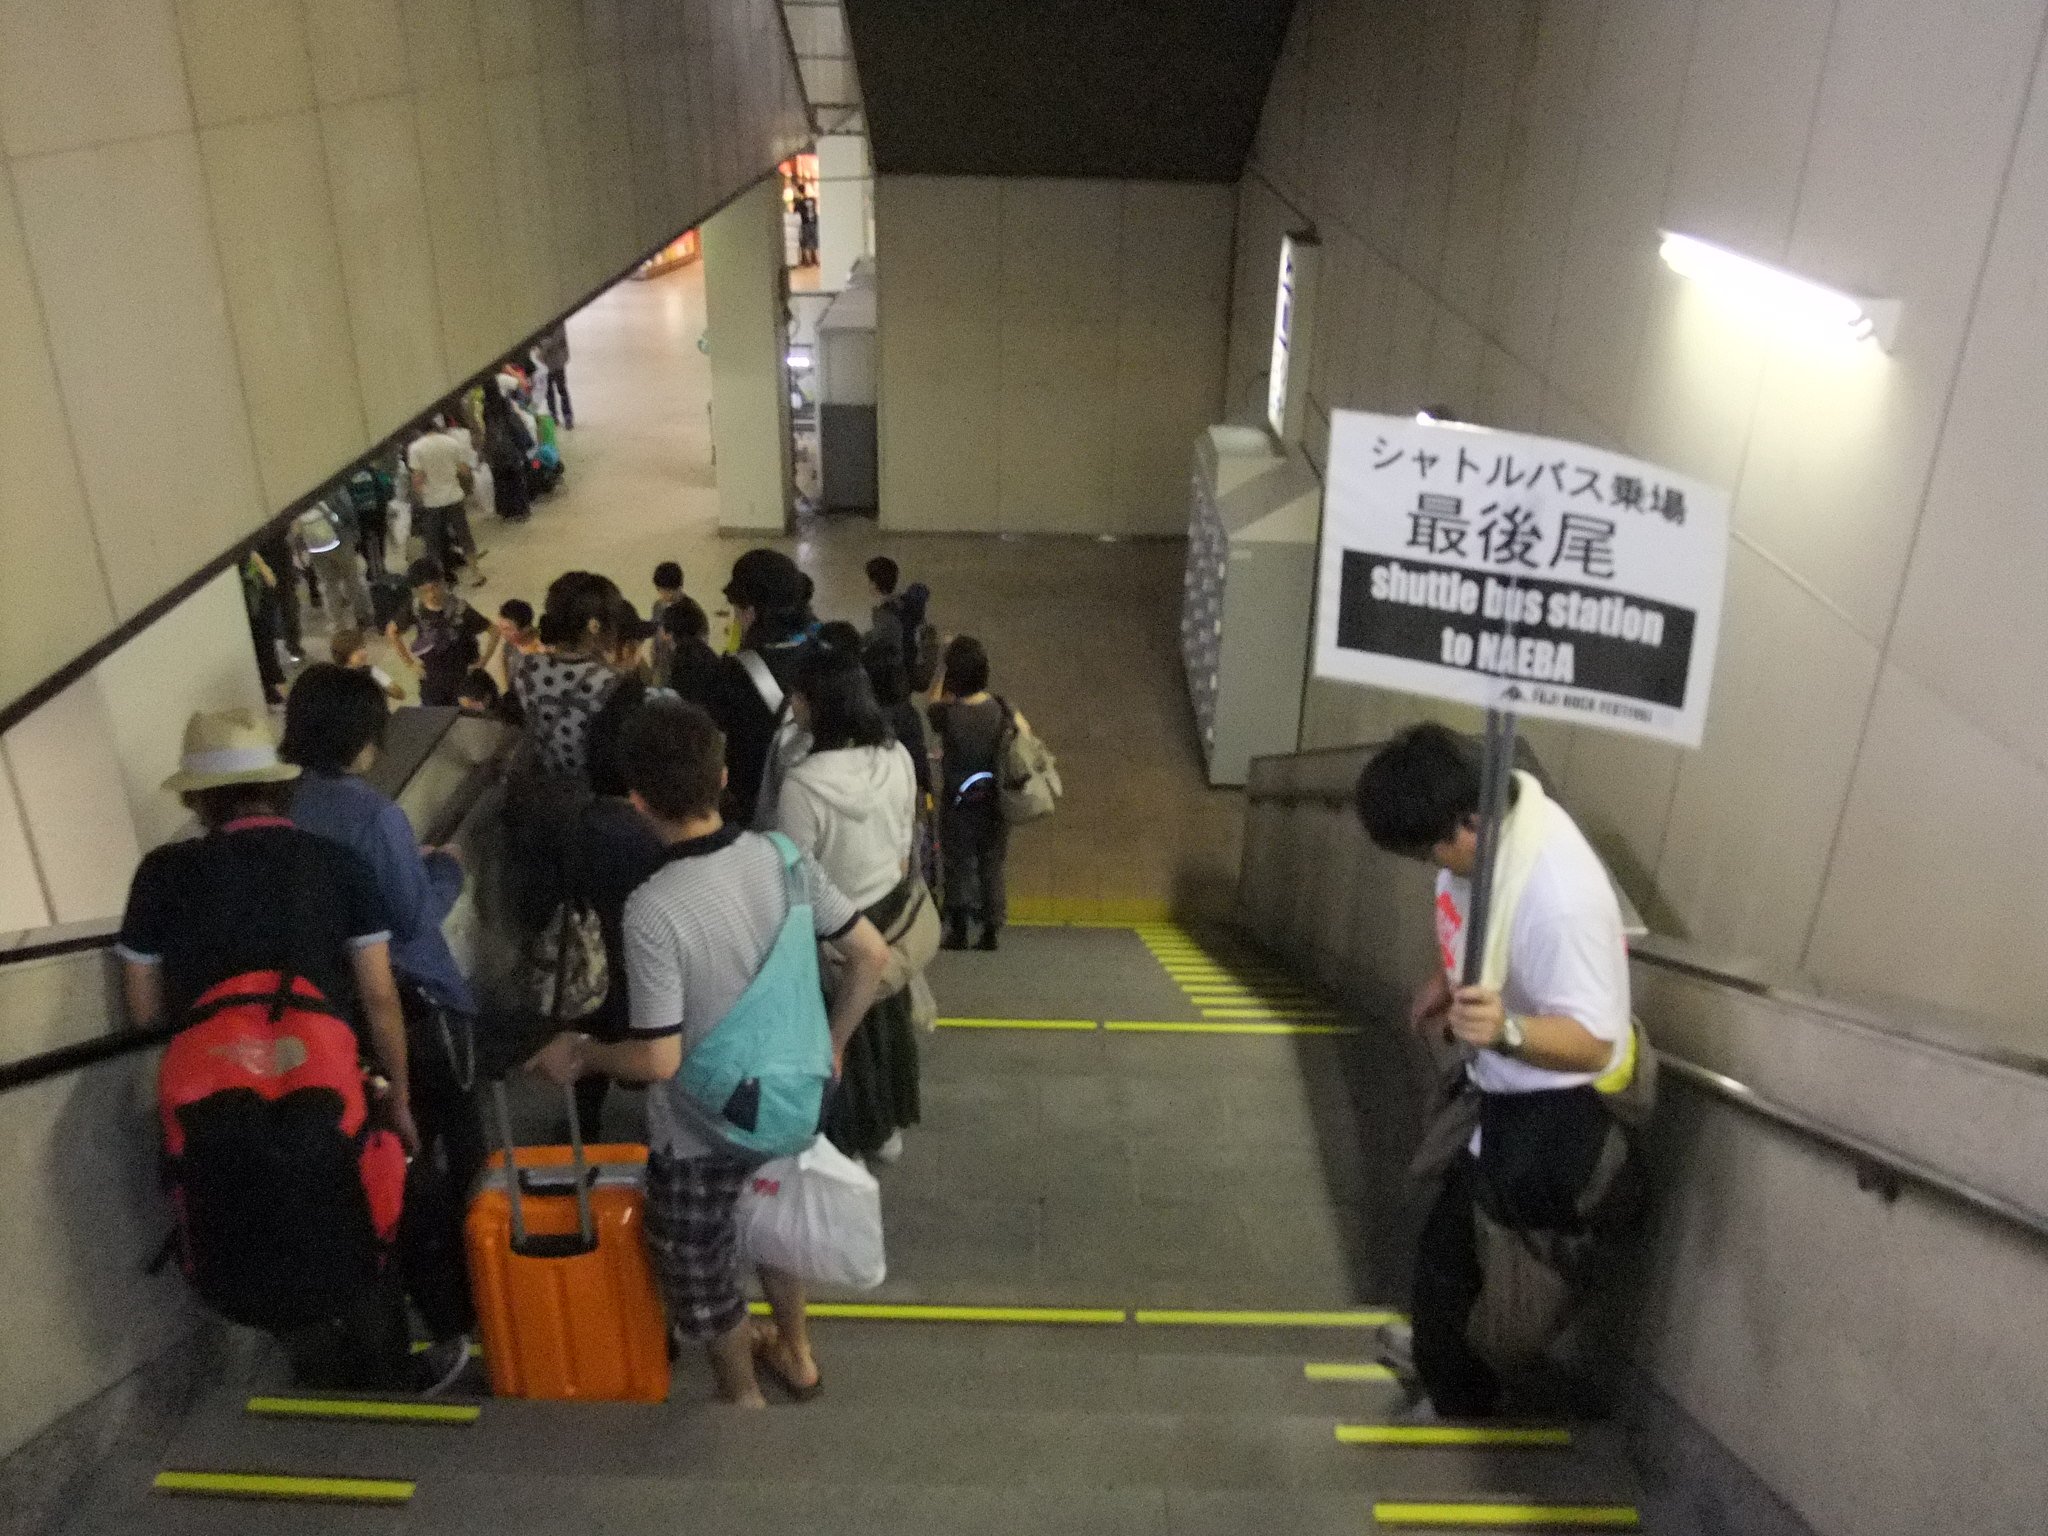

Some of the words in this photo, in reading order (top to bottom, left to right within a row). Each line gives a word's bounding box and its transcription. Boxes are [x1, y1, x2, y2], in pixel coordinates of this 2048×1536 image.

[1373, 436, 1687, 526] シャトルバス乗場
[1407, 494, 1616, 579] 最後尾
[1371, 561, 1479, 615] shuttle
[1482, 577, 1543, 625] bus
[1547, 591, 1664, 647] station
[1441, 626, 1473, 666] to
[1477, 631, 1575, 683] NAEBA
